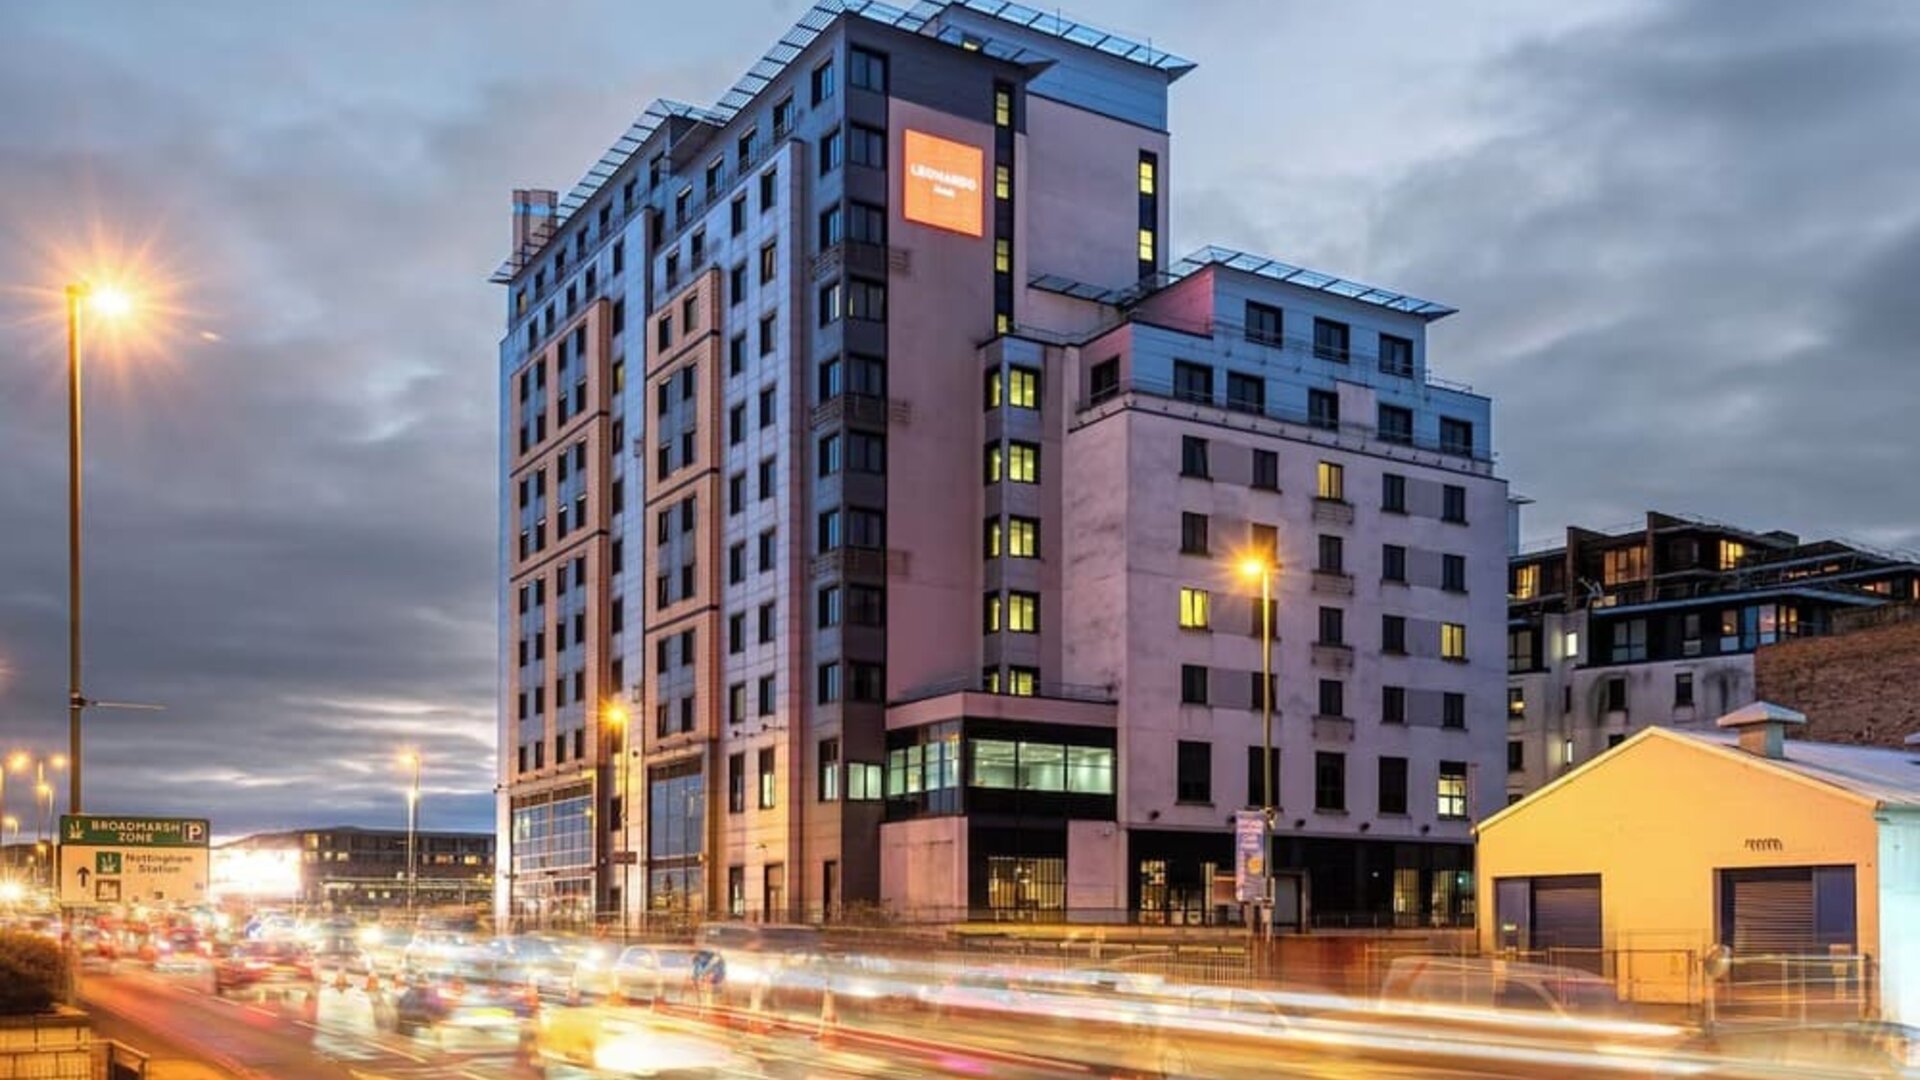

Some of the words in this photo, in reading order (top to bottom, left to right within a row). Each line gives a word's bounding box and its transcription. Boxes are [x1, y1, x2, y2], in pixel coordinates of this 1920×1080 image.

[910, 164, 977, 191] LEONARDO
[91, 820, 181, 833] BROADMARSH
[188, 824, 202, 839] P
[118, 832, 153, 843] ZONE
[125, 853, 193, 864] Nottingham
[138, 864, 181, 874] Station
